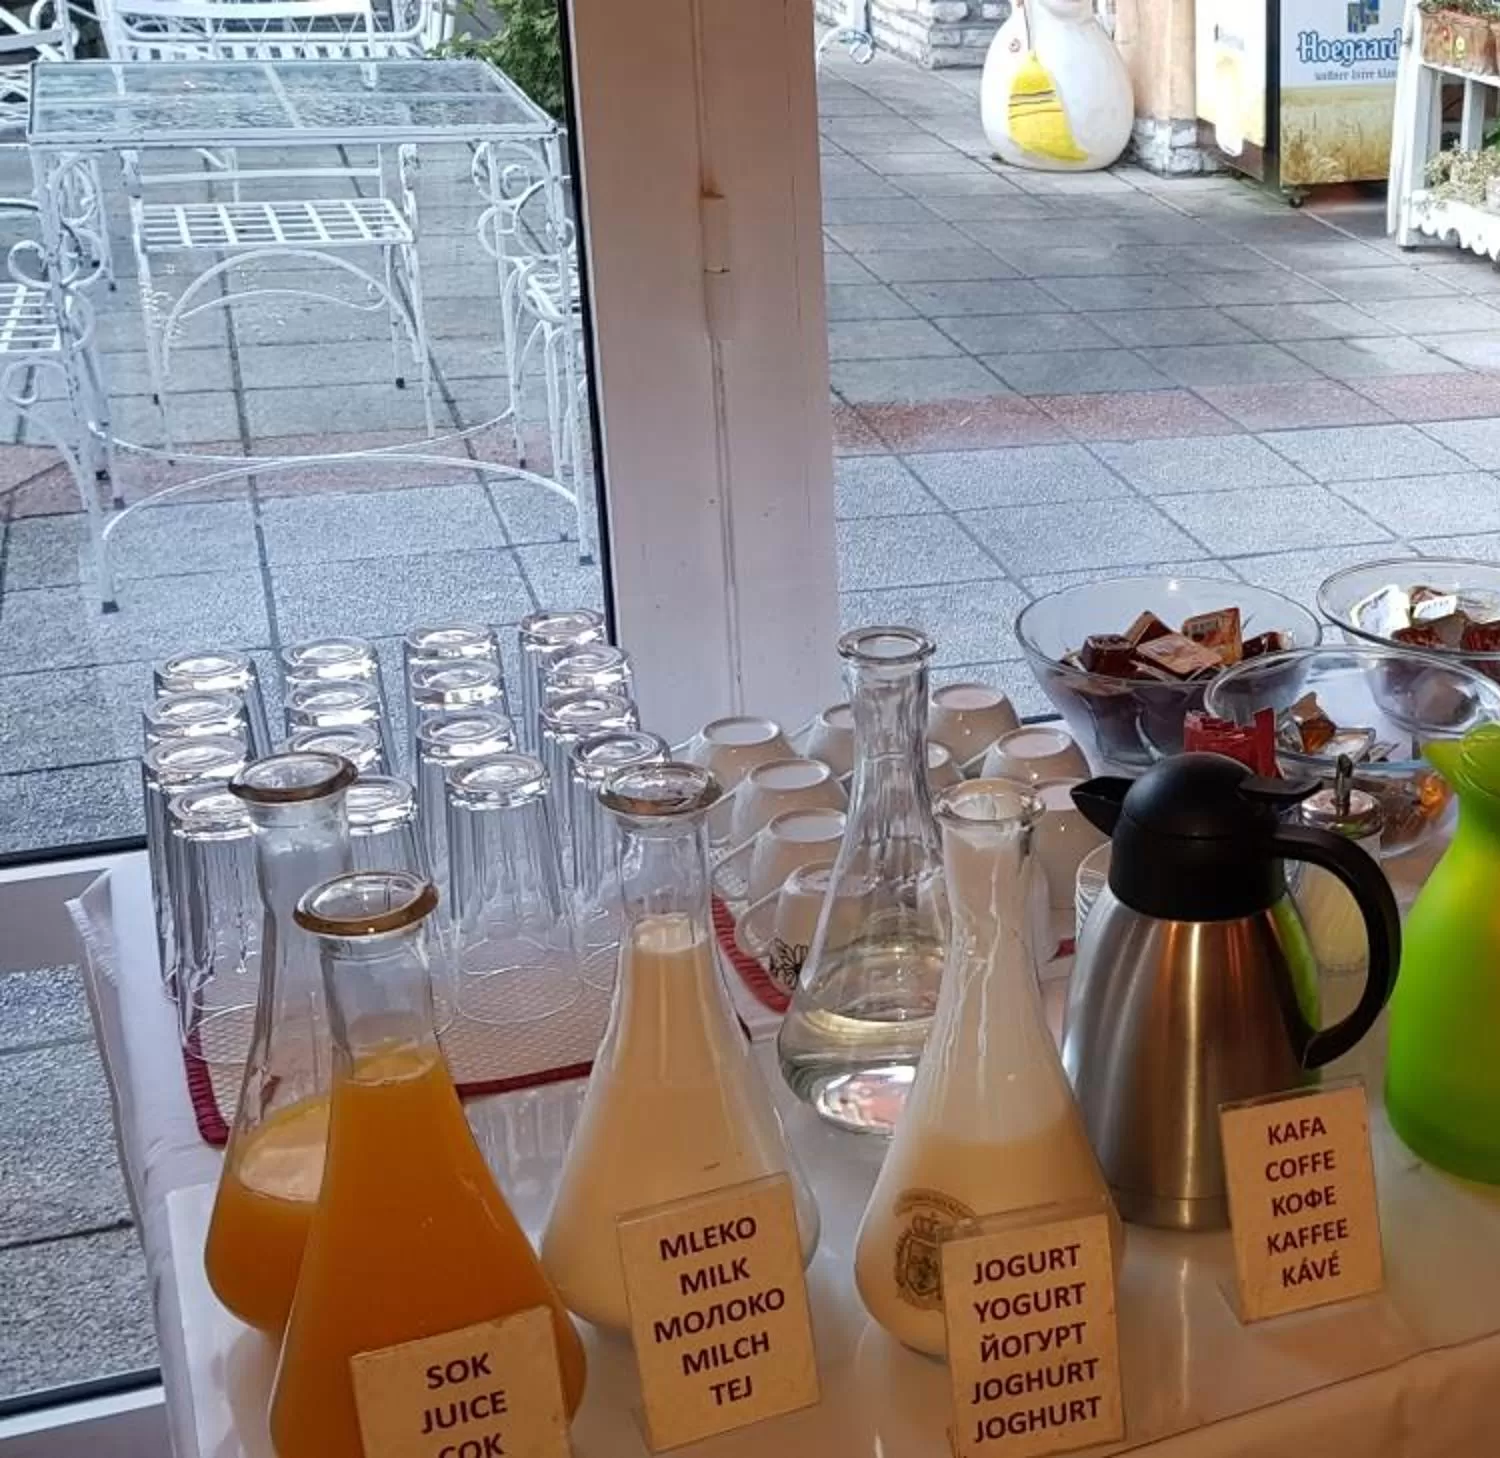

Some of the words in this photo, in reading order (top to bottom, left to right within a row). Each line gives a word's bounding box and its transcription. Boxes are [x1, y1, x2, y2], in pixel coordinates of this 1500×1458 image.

[1267, 1116, 1327, 1146] KAFA
[1265, 1149, 1336, 1182] COFFE
[1271, 1185, 1337, 1217] КОФЕ
[659, 1216, 757, 1261] MLEKO
[1266, 1217, 1349, 1256] KAFFEE
[679, 1256, 751, 1296] MILK
[973, 1243, 1081, 1286] JOGURT
[1281, 1249, 1341, 1288] KÁVÉ
[653, 1287, 785, 1344] МОЛОКО
[973, 1281, 1087, 1323] YOGURT
[682, 1331, 770, 1376] MILCH
[980, 1321, 1087, 1363] ЙОГУРТ
[426, 1352, 492, 1390] SOK
[709, 1375, 753, 1406] TEJ
[971, 1357, 1099, 1405] JOGHURT
[421, 1390, 508, 1435] JUICE
[975, 1395, 1102, 1444] JOGHURT
